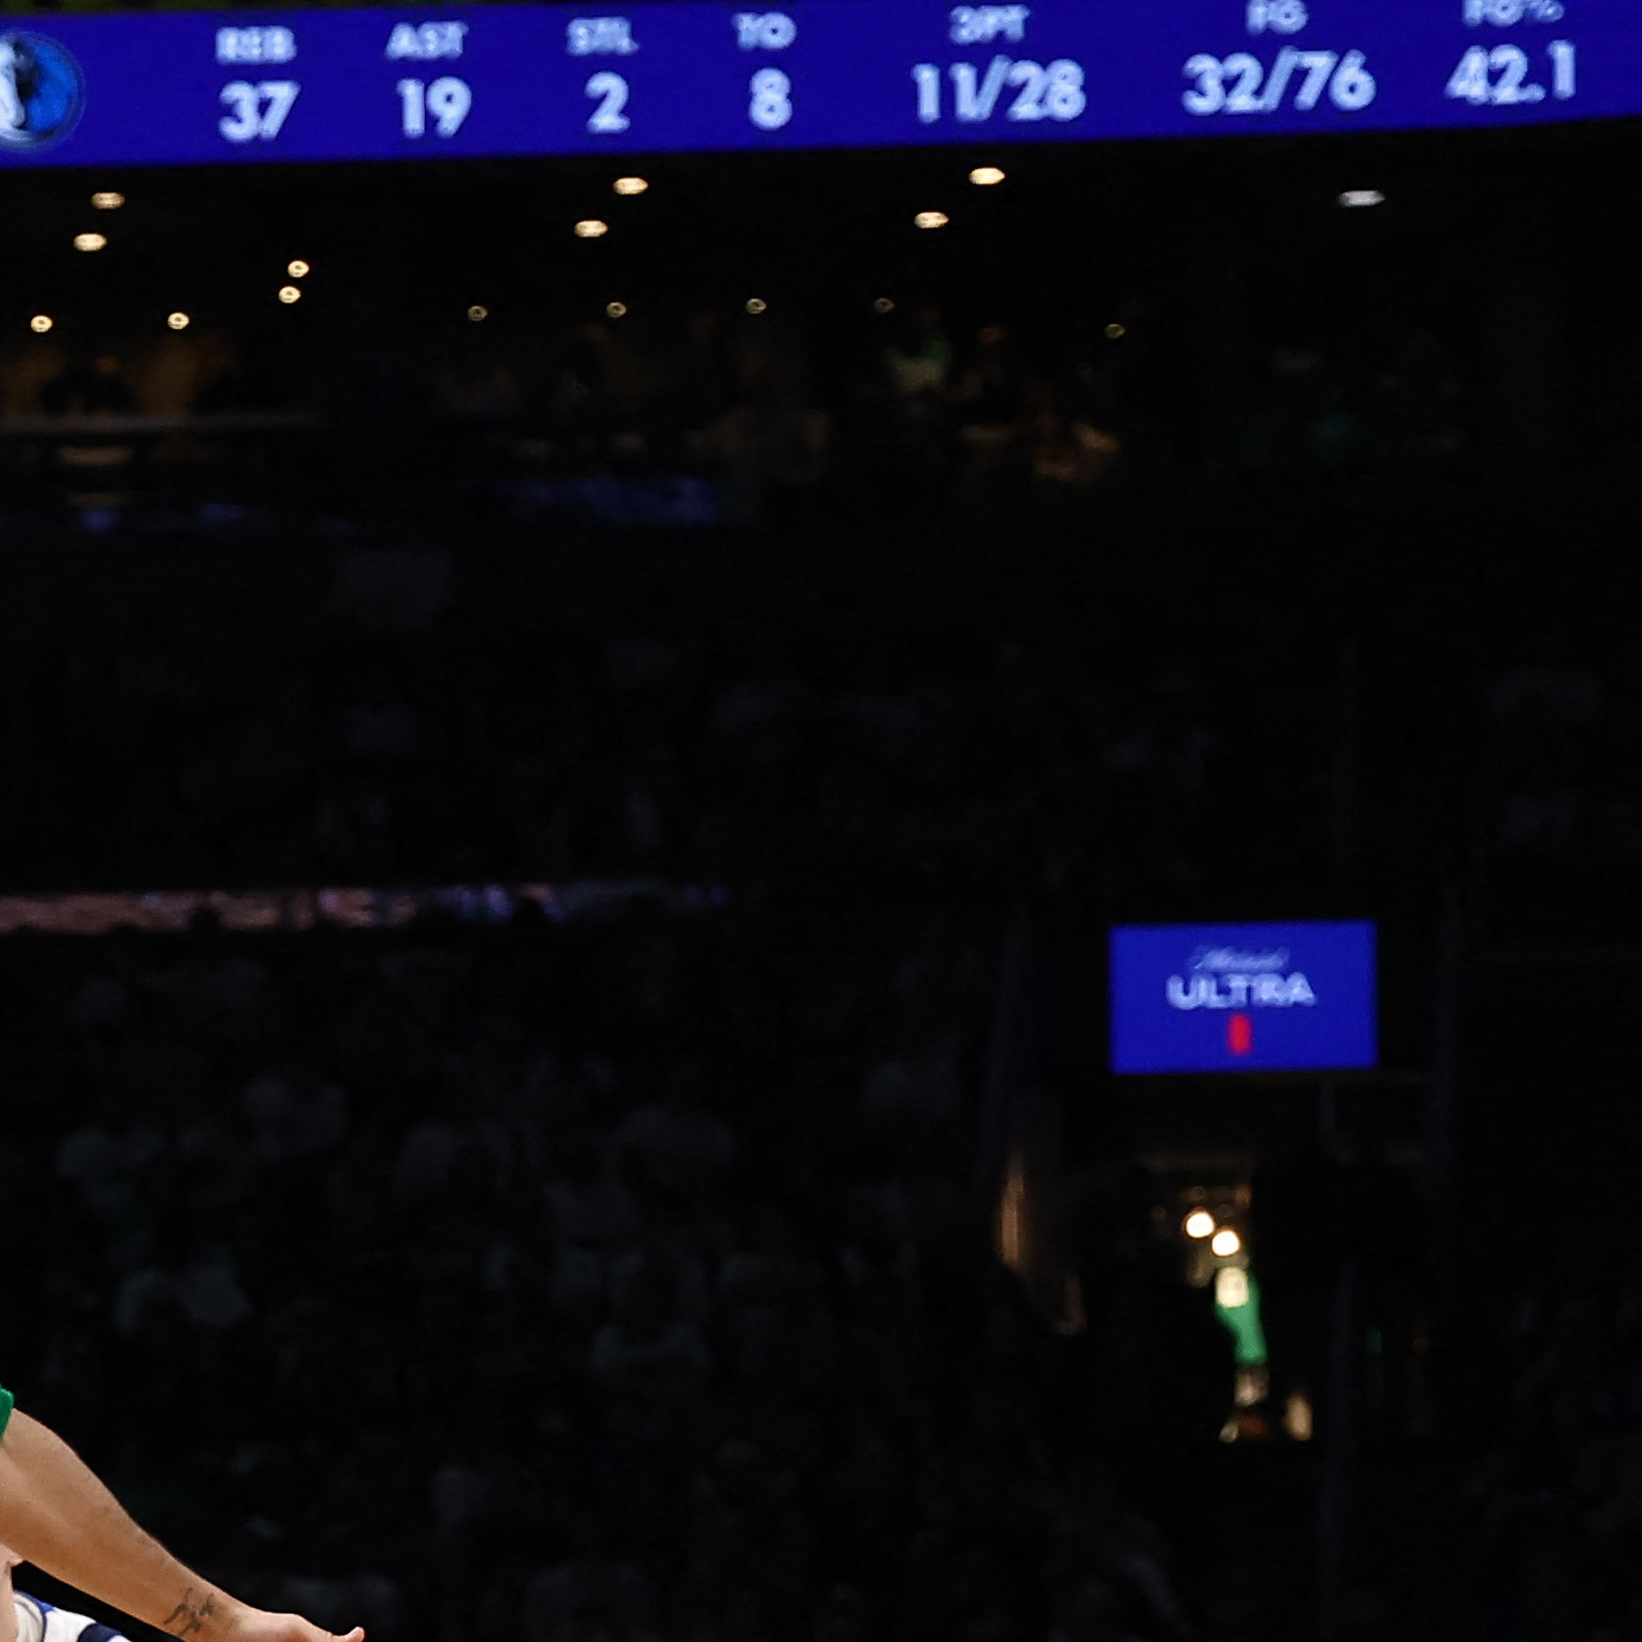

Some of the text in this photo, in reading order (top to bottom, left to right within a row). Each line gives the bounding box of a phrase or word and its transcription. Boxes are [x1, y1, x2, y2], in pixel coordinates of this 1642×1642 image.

[386, 21, 469, 60] AST
[731, 12, 796, 50] TO
[219, 40, 1576, 142] 37 19 2 8 11/28 32/76 42.1
[1166, 971, 1316, 1010] ULTRA
